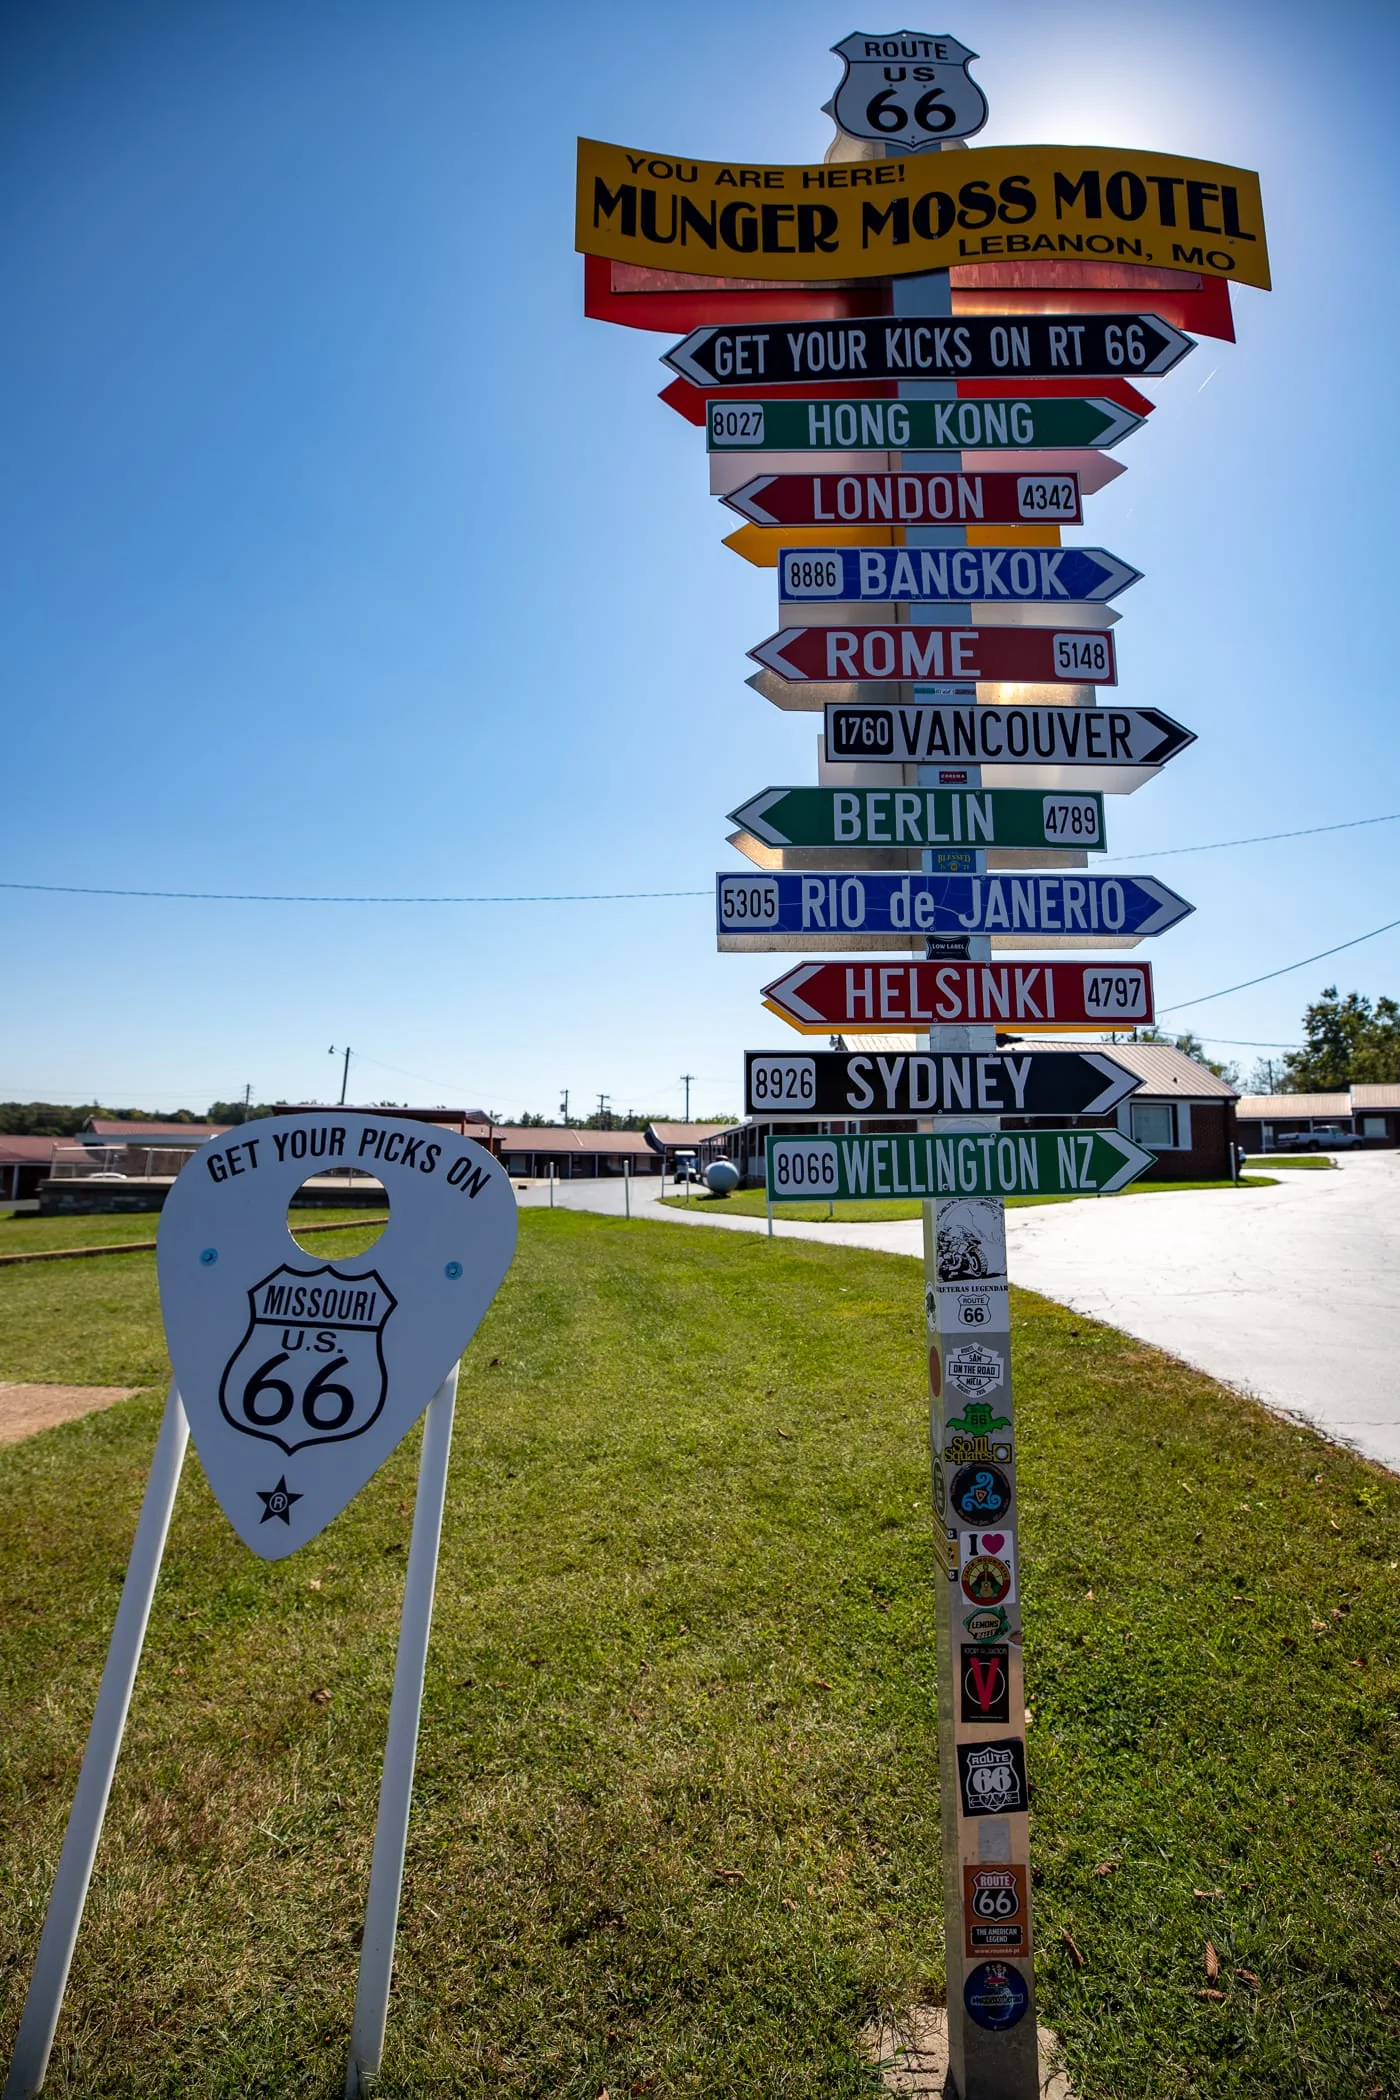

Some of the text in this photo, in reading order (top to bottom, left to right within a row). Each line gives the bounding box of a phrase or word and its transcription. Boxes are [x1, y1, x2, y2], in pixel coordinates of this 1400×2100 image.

[864, 40, 949, 61] ROUTE
[883, 66, 935, 83] US
[866, 88, 957, 133] 66
[625, 154, 906, 190] YOU ARE HERE!
[593, 170, 1257, 254] MUNGER MOSS MOTEL
[958, 234, 1236, 271] LEBANON, MO
[714, 324, 1146, 377] GET YOUR KICKS ON RT 66
[712, 401, 1034, 447] 8027 HONG KONG
[812, 476, 1074, 521] LONDON 4342
[790, 551, 1069, 596] 8886 BANGKOK
[825, 631, 1106, 678] ROME 5148
[839, 709, 1134, 759] 1760 VANCOUVER
[833, 793, 1097, 842] BERLIN 4789
[937, 854, 971, 863] BLESSED
[723, 878, 1127, 930] 5305 RIO de JANERIO
[845, 967, 1142, 1020] HELSINKI 4797
[754, 1056, 1034, 1110] 8926 SYDNEY
[206, 1126, 492, 1200] GET YOUR PICKS ON
[777, 1135, 1098, 1195] 8066 WELLINGTON NZ
[263, 1285, 377, 1322] MISSOURI
[964, 1307, 985, 1323] 66
[281, 1329, 345, 1354] U.S.
[953, 1365, 996, 1375] ON THE ROAD
[969, 1354, 982, 1362] SAM
[242, 1352, 355, 1431] 66
[971, 1414, 986, 1424] 66
[944, 1447, 993, 1465] Squares
[952, 1436, 971, 1452] So
[969, 1534, 979, 1556] I
[972, 1620, 999, 1629] LEMONS
[971, 1753, 1009, 1765] ROUTE
[972, 1766, 1012, 1794] 66
[980, 1875, 1010, 1887] ROUTE
[979, 1889, 1012, 1914] 66
[976, 1927, 1018, 1936] THE AMERICAN
[986, 1935, 1008, 1943] LEGEND
